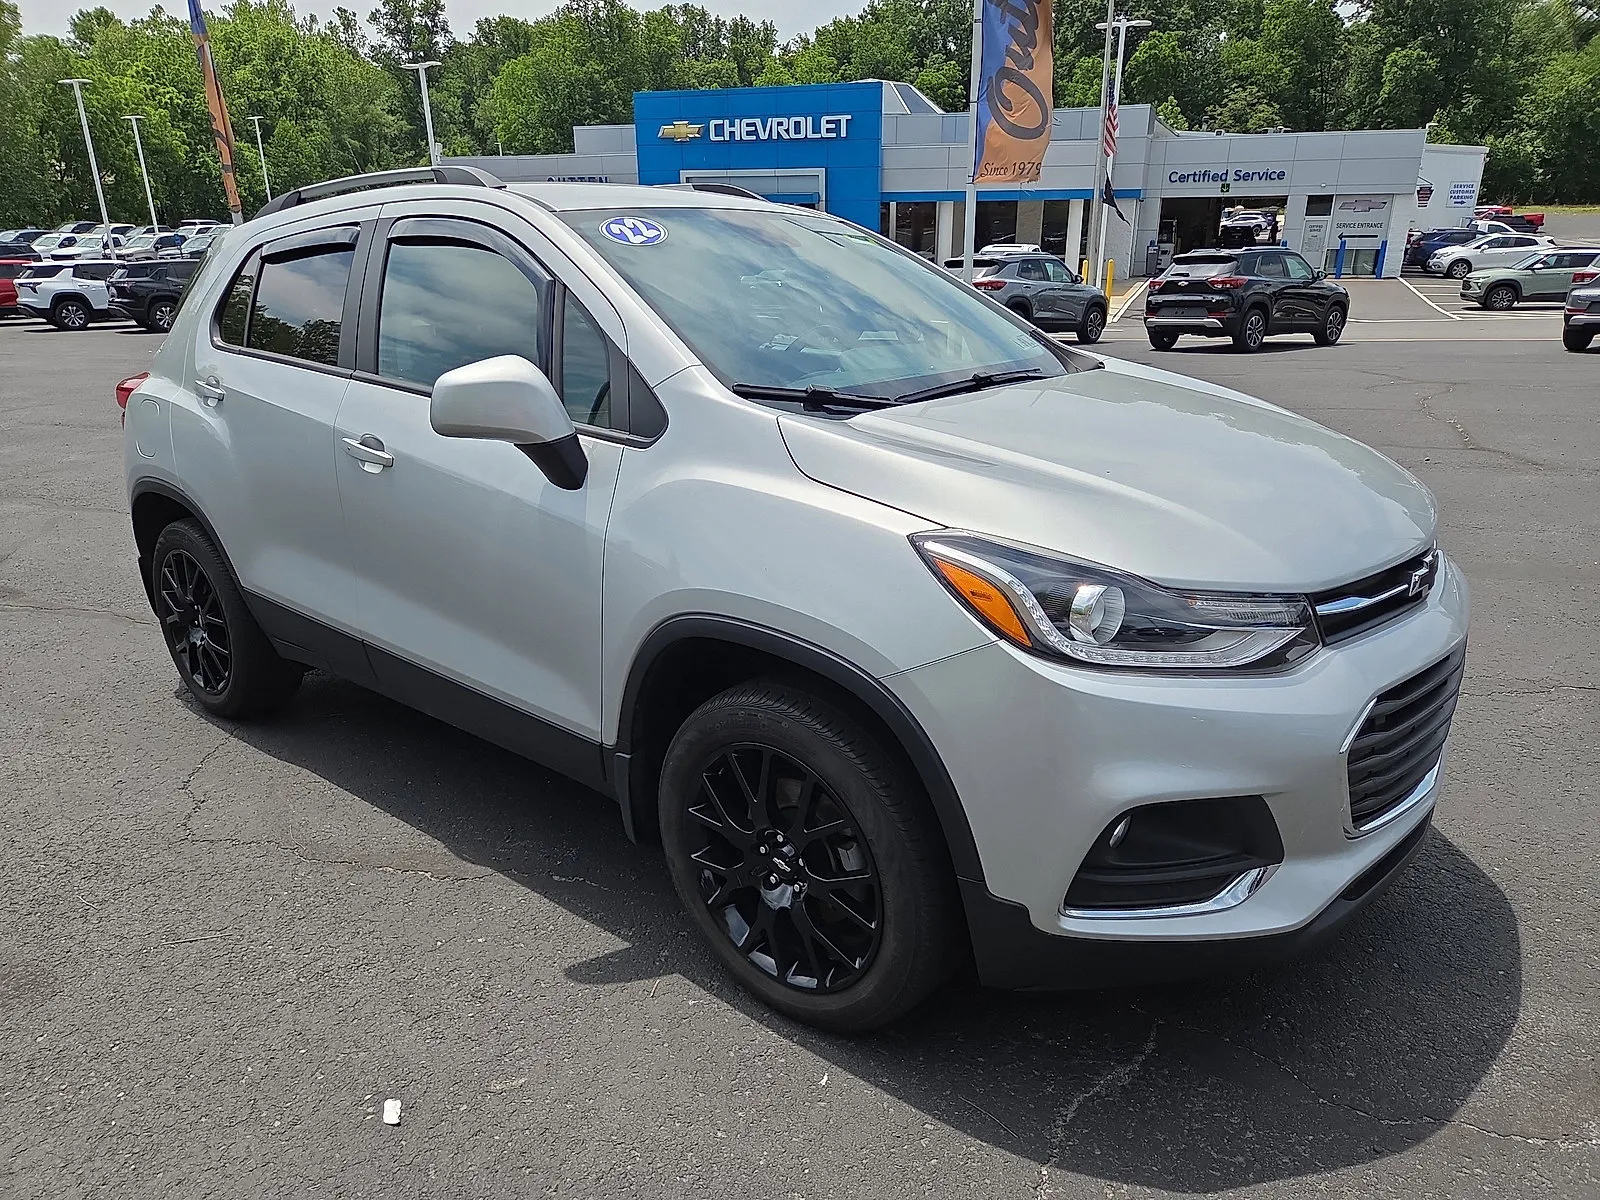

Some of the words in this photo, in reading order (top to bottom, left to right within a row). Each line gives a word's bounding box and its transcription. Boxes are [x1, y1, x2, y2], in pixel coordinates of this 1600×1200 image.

[709, 114, 852, 141] CHEVROLET
[980, 162, 1009, 178] Since
[1012, 161, 1042, 176] 1979
[1168, 169, 1229, 183] Certified
[1232, 168, 1286, 182] Service
[608, 217, 661, 245] 22
